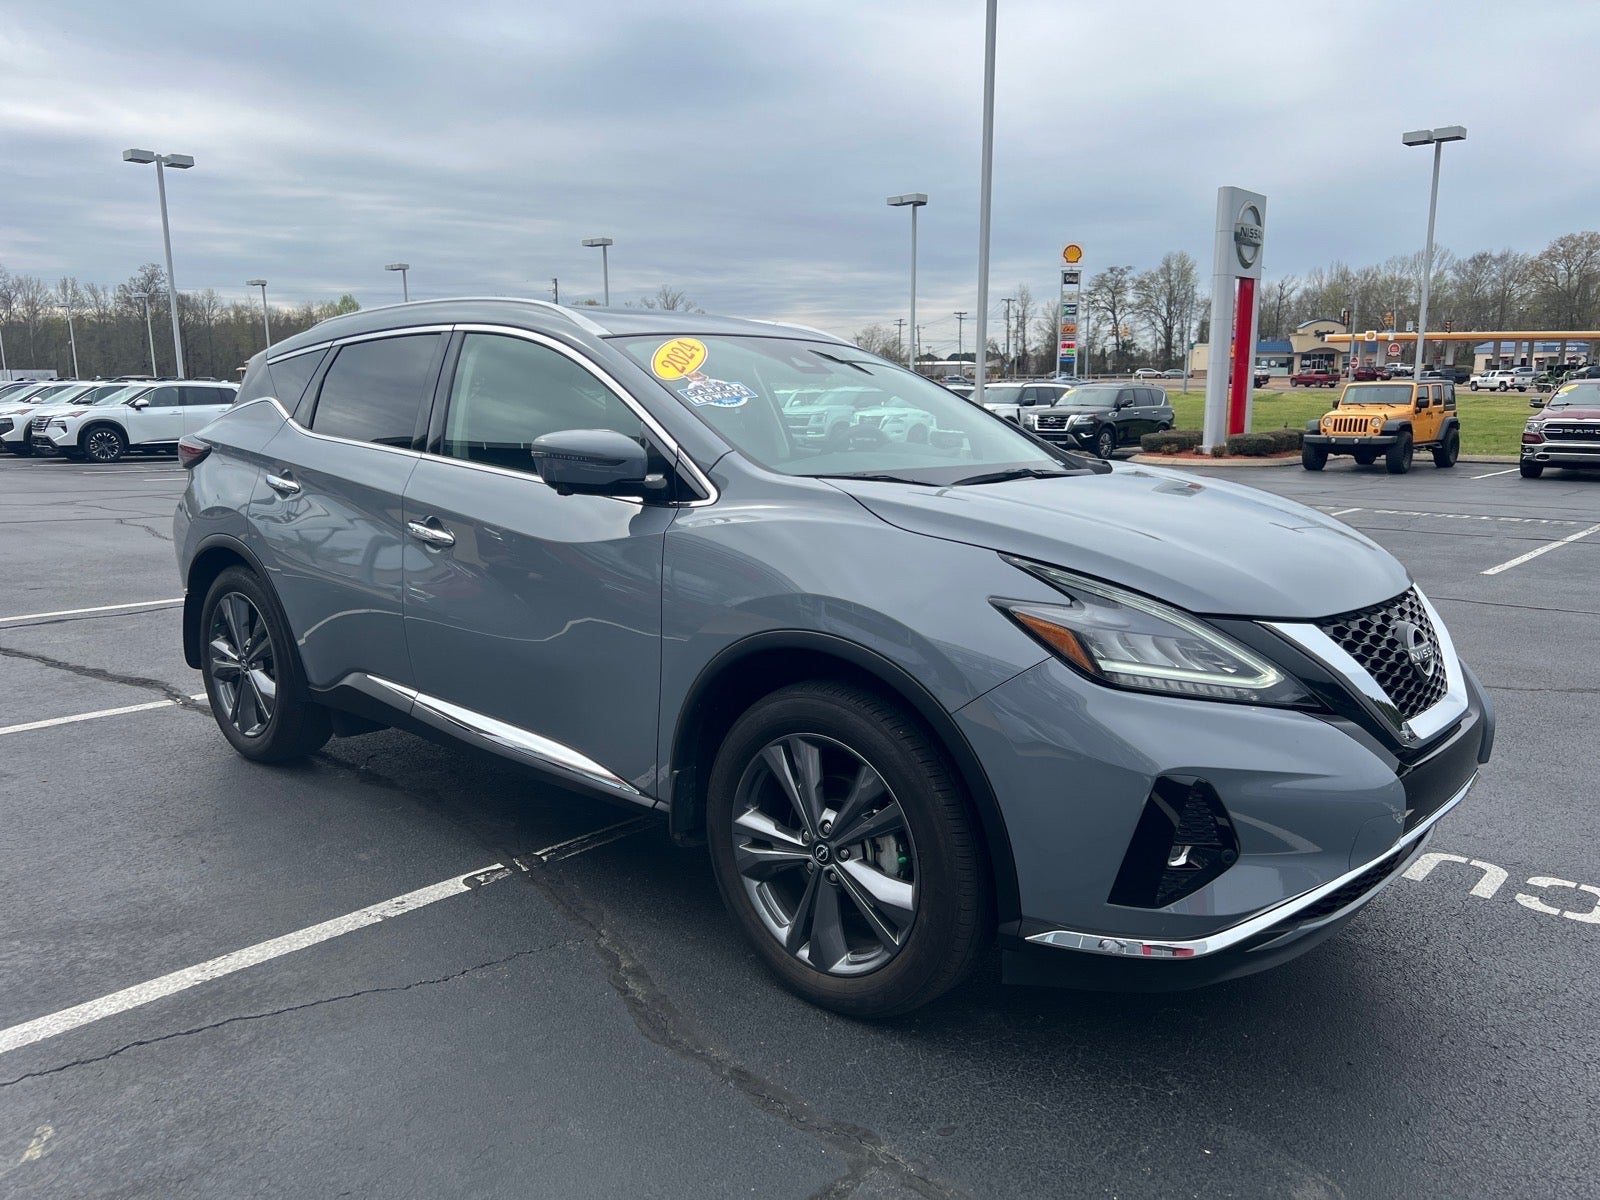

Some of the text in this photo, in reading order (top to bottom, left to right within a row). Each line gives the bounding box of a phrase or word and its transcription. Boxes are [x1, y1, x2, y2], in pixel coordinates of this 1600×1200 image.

[1239, 226, 1263, 240] NISSA
[661, 340, 701, 374] 2024
[686, 384, 746, 397] CARFAX
[1410, 646, 1432, 661] NISS
